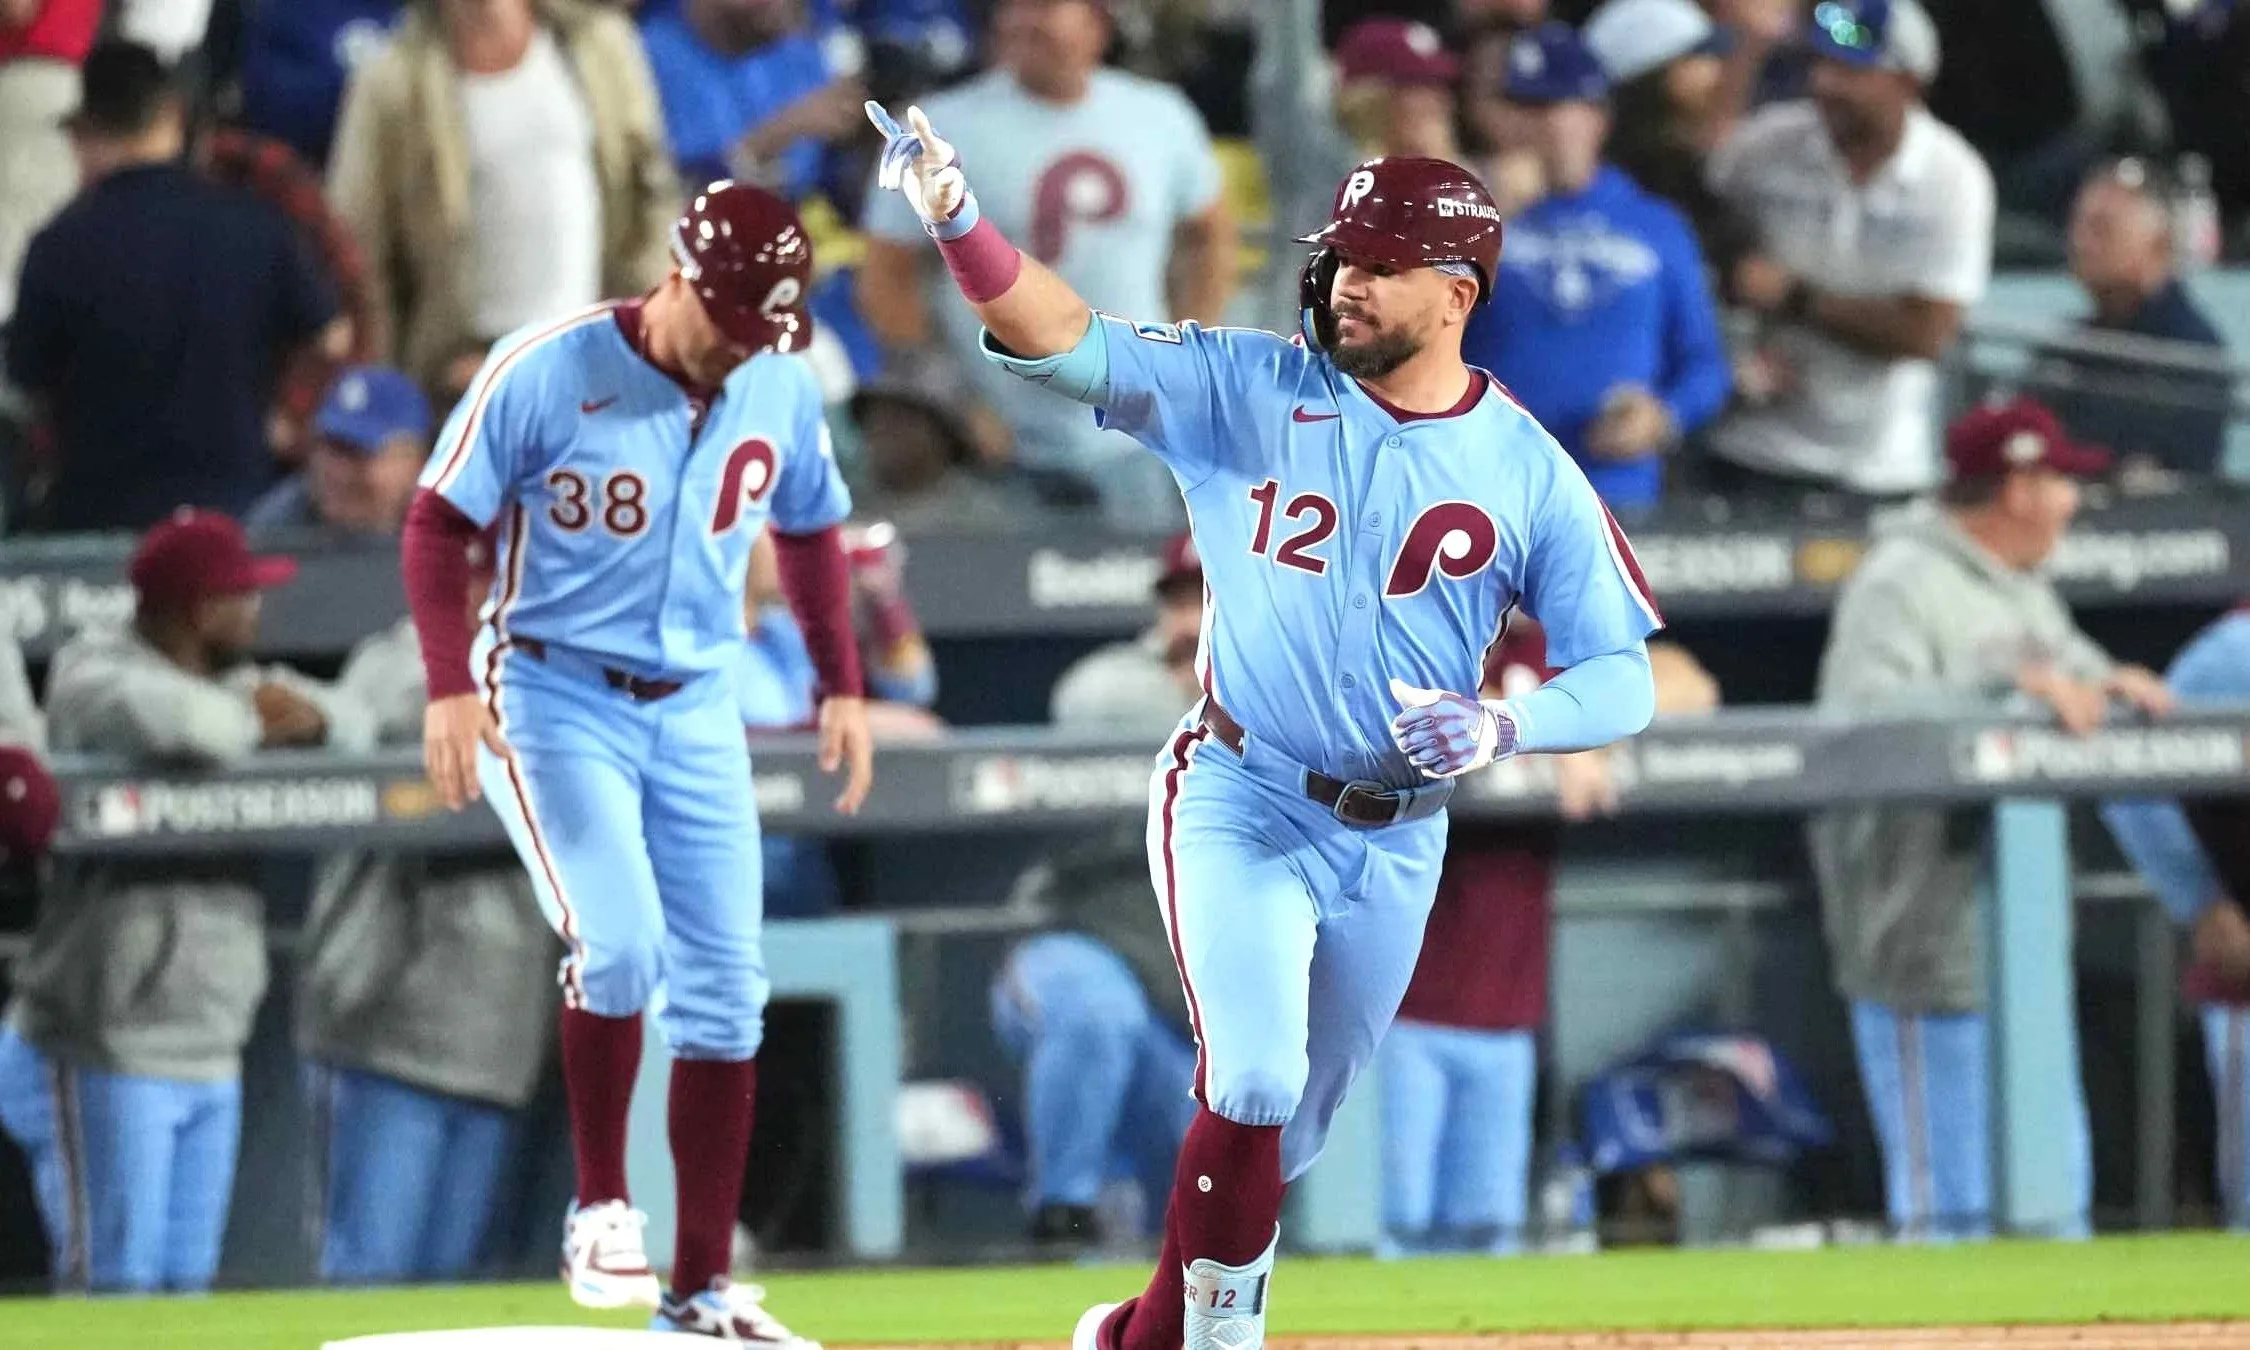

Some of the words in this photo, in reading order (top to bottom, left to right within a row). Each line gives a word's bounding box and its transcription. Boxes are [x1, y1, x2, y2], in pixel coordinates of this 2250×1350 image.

[1030, 150, 1130, 268] P
[1340, 170, 1375, 212] P
[759, 277, 800, 315] P
[546, 465, 651, 536] 38
[710, 434, 780, 537] P
[1248, 477, 1340, 578] 12
[1381, 499, 1500, 599] P
[1209, 1288, 1237, 1308] 12
